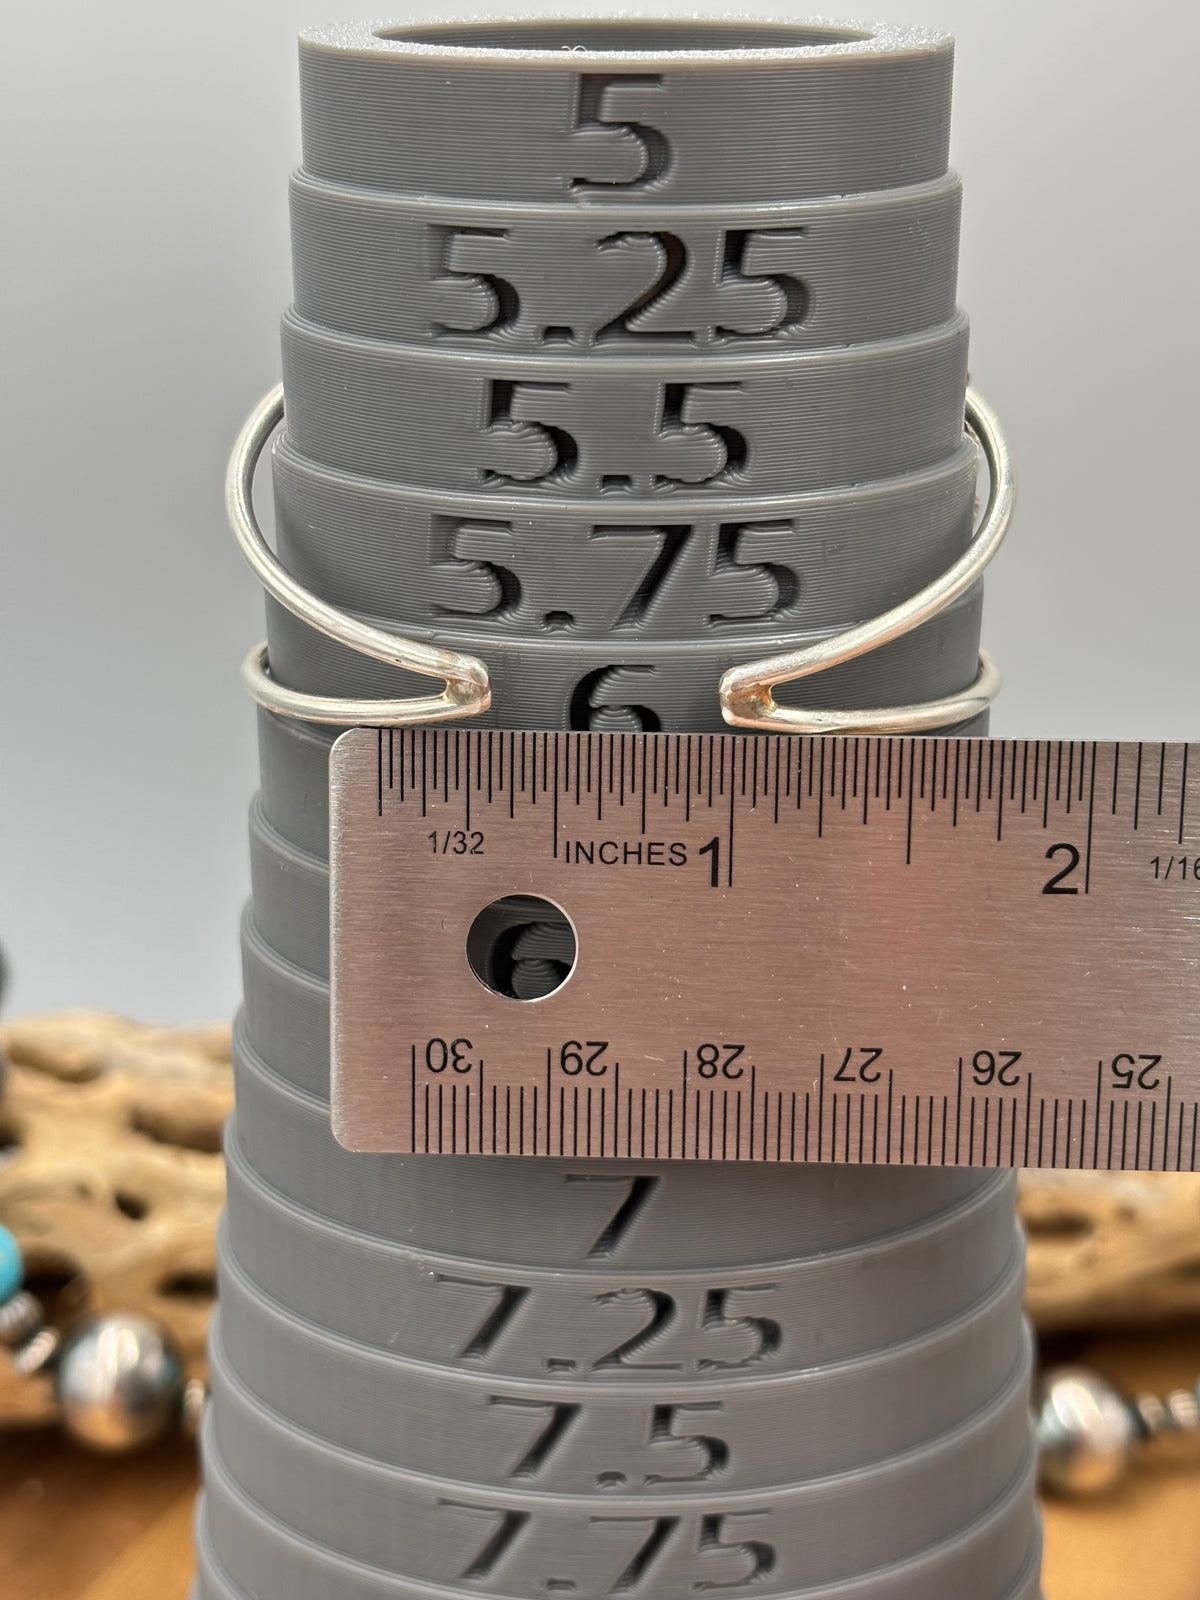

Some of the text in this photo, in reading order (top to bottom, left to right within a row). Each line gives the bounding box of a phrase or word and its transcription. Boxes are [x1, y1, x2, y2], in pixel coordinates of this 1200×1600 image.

[564, 73, 673, 194] 5
[424, 226, 812, 346] 5.25
[476, 378, 750, 492] 5.5
[427, 514, 800, 630] 5.75
[427, 830, 485, 855] 1/32
[565, 840, 688, 866] INCHES
[698, 837, 719, 888] 1
[1042, 843, 1080, 895] 2
[424, 1038, 473, 1073] 30
[560, 1041, 609, 1076] 29
[697, 1044, 745, 1079] 28
[833, 1047, 883, 1083] 27
[971, 1050, 1023, 1086] 26
[1111, 1053, 1162, 1090] 25
[563, 1174, 663, 1259] 7
[430, 1272, 784, 1373] 7.25
[487, 1394, 733, 1486] 7.5
[437, 1499, 778, 1595] 7.75
